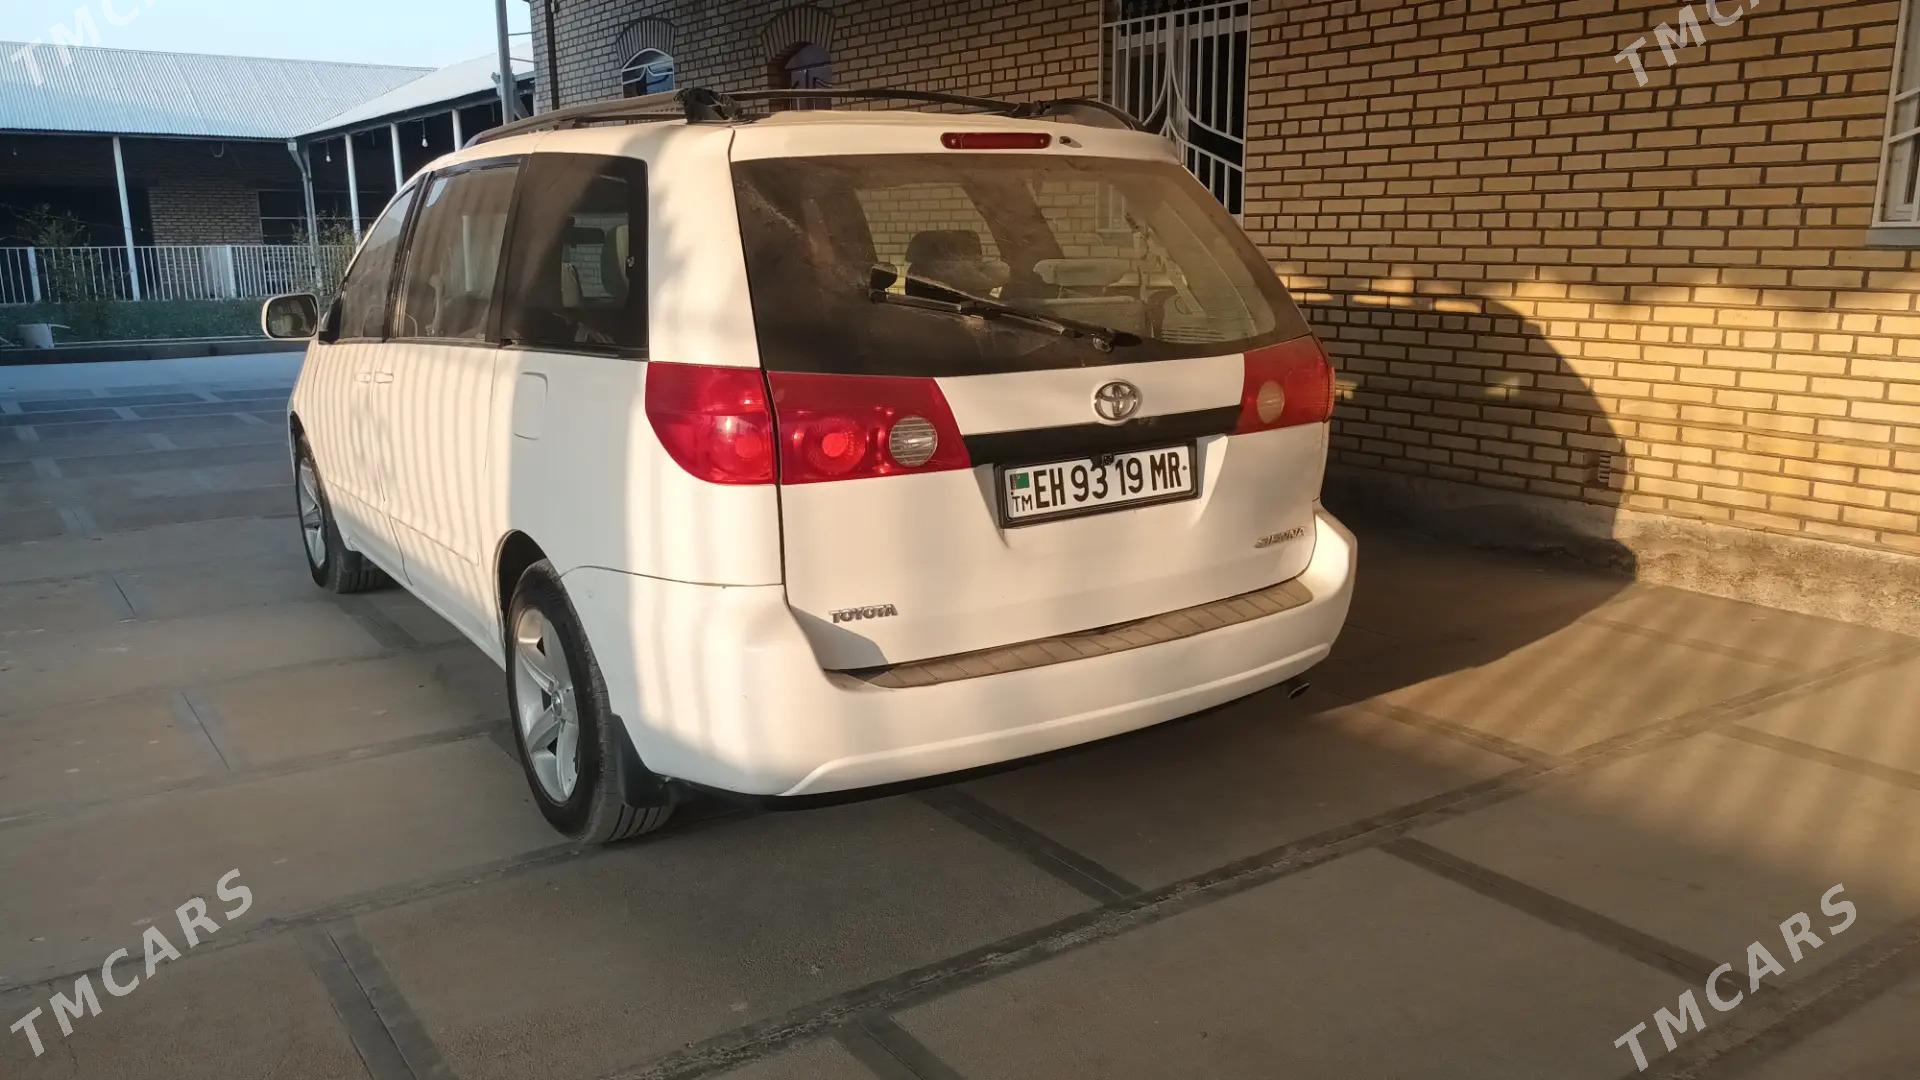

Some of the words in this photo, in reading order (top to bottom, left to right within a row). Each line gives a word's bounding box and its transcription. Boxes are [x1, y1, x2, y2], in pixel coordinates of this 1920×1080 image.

[1033, 467, 1066, 509] EH
[1070, 464, 1109, 502] 93
[1115, 457, 1144, 496] 19
[1149, 451, 1182, 491] MR
[1011, 494, 1033, 513] TM
[829, 603, 898, 624] TOYOTA
